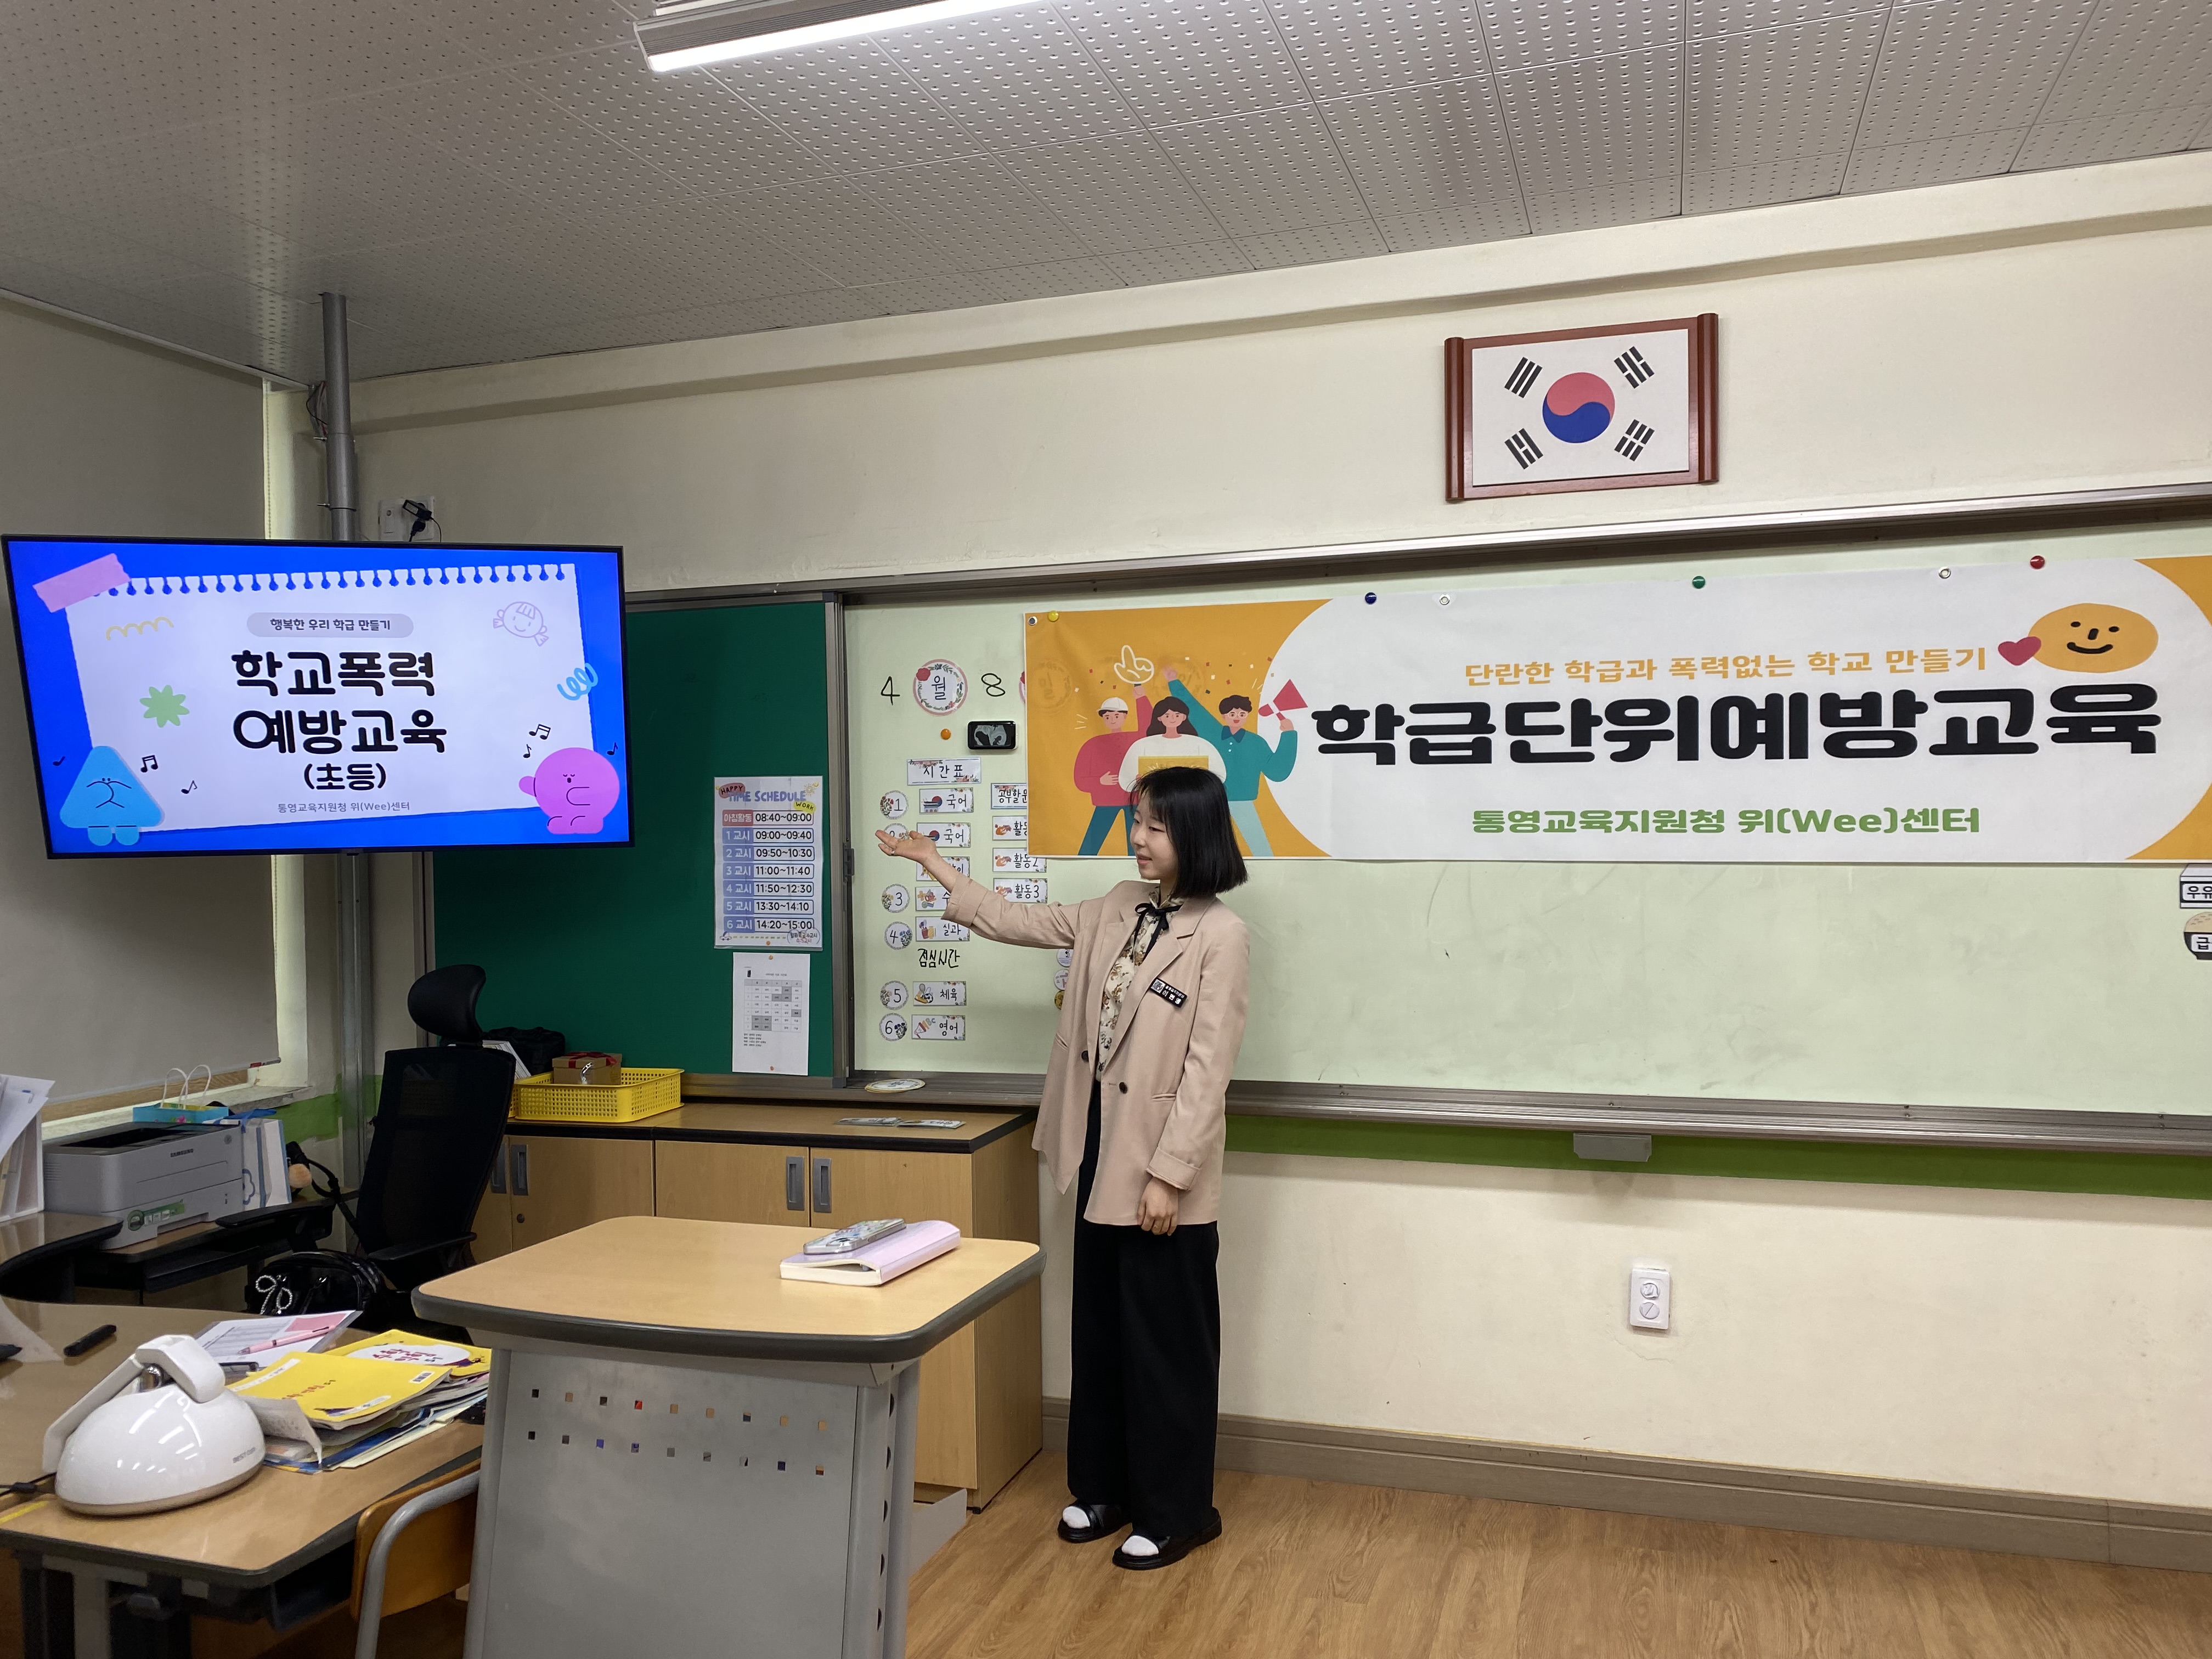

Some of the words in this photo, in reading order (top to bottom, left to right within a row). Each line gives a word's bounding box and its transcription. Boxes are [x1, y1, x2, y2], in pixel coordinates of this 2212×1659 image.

[270, 618, 305, 631] 행복한
[308, 619, 330, 630] 우리
[332, 618, 355, 631] 학급
[358, 619, 391, 631] 만들기
[231, 649, 436, 698] 학교폭력
[1465, 661, 1554, 687] 단란한
[1564, 657, 1658, 683] 학급과
[1668, 653, 1796, 680] 폭력없는
[1807, 650, 1872, 674] 학교
[1884, 646, 1986, 674] 만들기
[881, 676, 900, 706] 4
[930, 675, 947, 701] 월
[981, 673, 1006, 697] 8
[1311, 682, 2160, 767] 학급단위예방교육
[232, 708, 448, 756] 예방교육
[303, 763, 387, 791] (초등)
[720, 785, 743, 795] HAPPY
[754, 790, 806, 802] SCHEDULE
[277, 803, 347, 813] 통영교육지원청
[350, 802, 410, 812] 위(Wee)센터
[795, 802, 815, 811] WORK
[894, 798, 904, 812] 1
[946, 794, 967, 809] 국어
[724, 813, 753, 823] 아침활동
[755, 812, 812, 822] 08:40~09:00
[1471, 807, 1726, 835] 통영교육지원청
[1737, 806, 1980, 835] 위(Wee)센터
[733, 830, 751, 841] 교시
[755, 830, 812, 840] 09:00~09:40
[943, 829, 965, 844] 국어
[733, 848, 752, 859] 교시
[756, 848, 812, 858] 09:50~10:30
[734, 866, 752, 876] 교시
[755, 866, 810, 876] 11:00~11:40
[734, 883, 752, 894] 교시
[755, 883, 812, 894] 11:50~12:30
[1014, 883, 1040, 899] 활동3
[2187, 886, 2211, 899] 우유
[894, 892, 903, 906] 3
[735, 901, 752, 912] 교시
[756, 901, 809, 911] 13:30~14:10
[735, 919, 753, 930] 교시
[756, 919, 812, 929] 14:20~15:00
[943, 923, 961, 936] 실과
[889, 929, 899, 944] 4
[2196, 936, 2211, 950] 급
[918, 948, 961, 968] 점심시간
[893, 989, 902, 1003] 5
[940, 988, 958, 1001] 체육
[884, 1020, 893, 1035] 6
[939, 1019, 958, 1036] 영어
